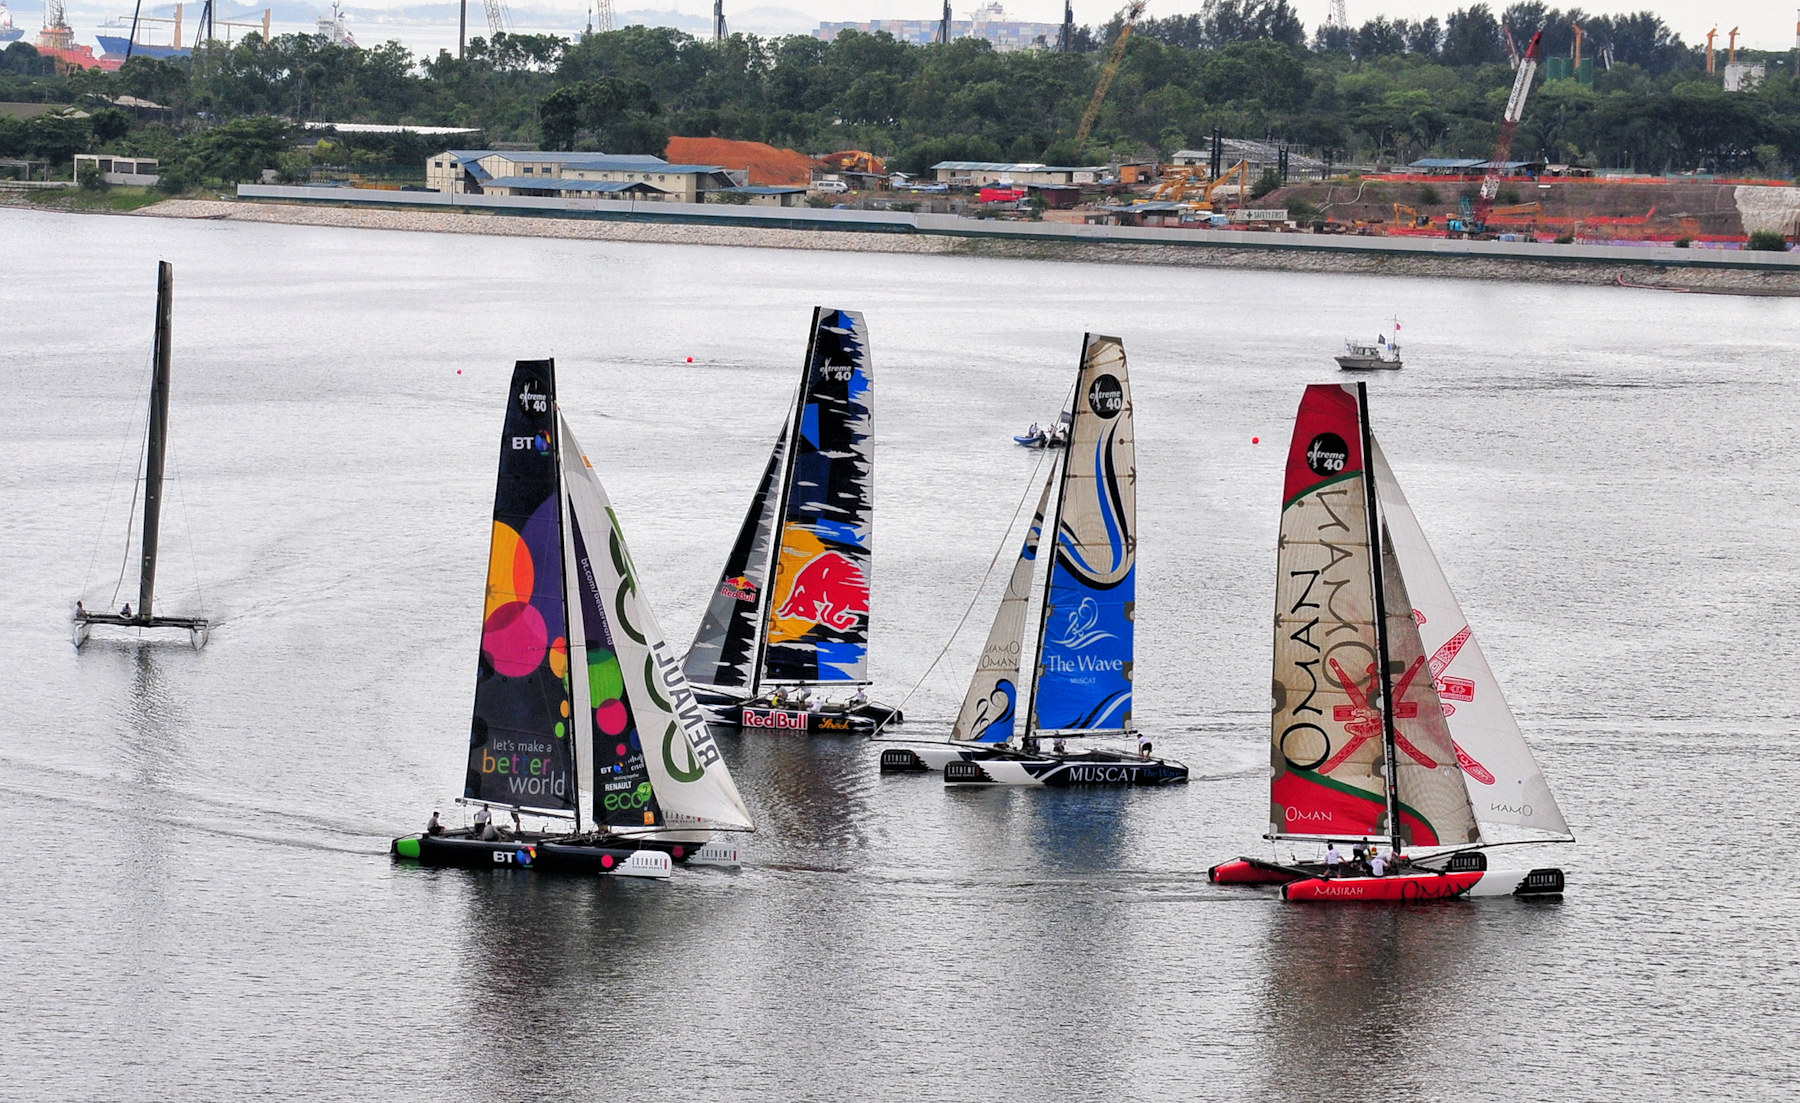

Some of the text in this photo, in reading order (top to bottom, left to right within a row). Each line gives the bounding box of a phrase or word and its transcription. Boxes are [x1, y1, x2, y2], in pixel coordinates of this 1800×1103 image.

[1254, 211, 1284, 219] SAFETY FIRST
[834, 371, 852, 381] 40
[533, 400, 547, 412] 40
[1106, 397, 1121, 409] 40
[512, 436, 534, 450] BT
[1323, 459, 1344, 471] 40
[721, 588, 756, 602] Red Bull
[1047, 654, 1123, 672] The Wave
[1280, 570, 1331, 771] OMAN
[743, 709, 809, 730] Red Bull
[517, 739, 545, 753] make
[546, 744, 553, 753] a
[482, 747, 552, 776] better
[600, 766, 612, 774] BT
[1068, 767, 1140, 782] MUSCAT
[508, 770, 566, 797] world
[604, 781, 632, 791] RENAULT
[493, 850, 515, 864] BT
[1313, 885, 1364, 896] MASIRAH
